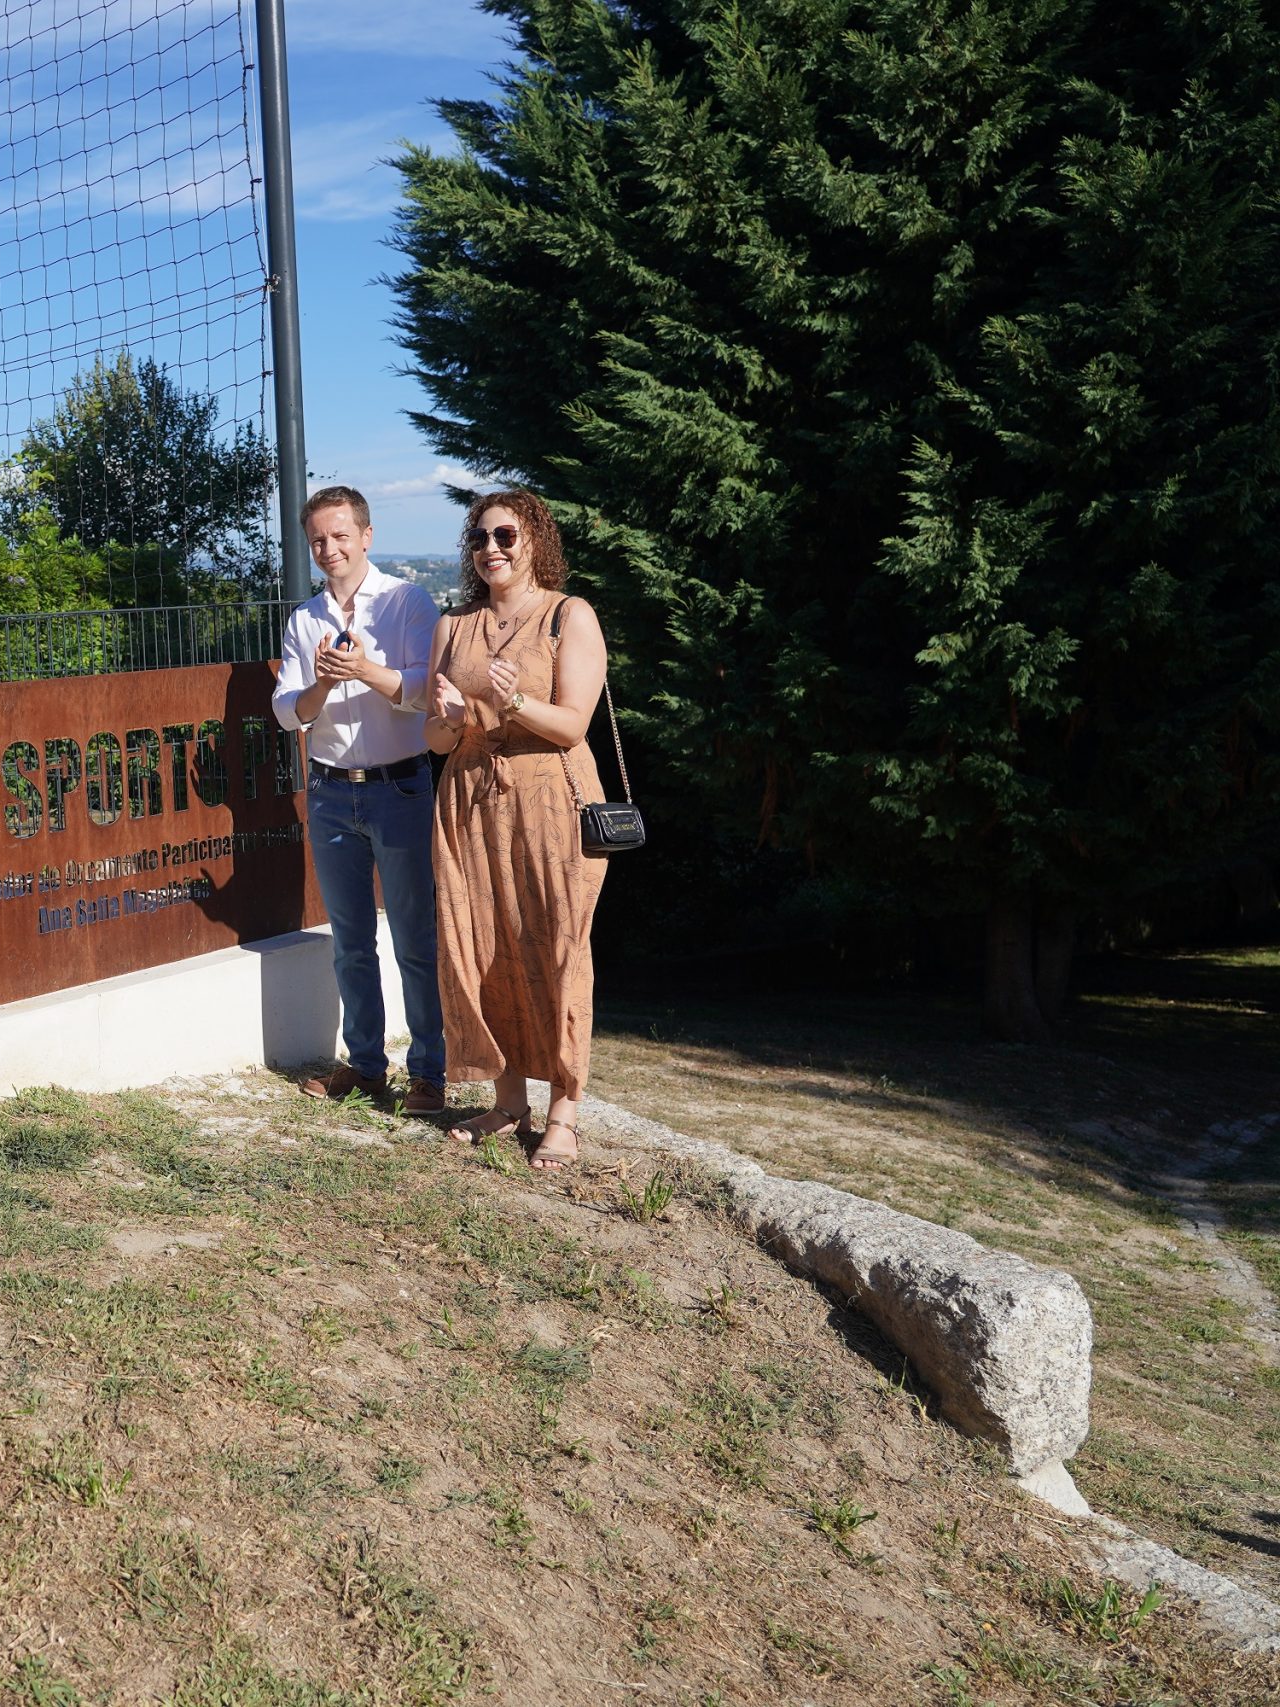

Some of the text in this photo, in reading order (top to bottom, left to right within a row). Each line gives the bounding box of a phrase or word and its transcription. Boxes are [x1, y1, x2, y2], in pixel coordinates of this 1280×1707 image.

[0, 717, 228, 839] SPORTS
[38, 905, 73, 935] Ana
[76, 893, 120, 928] Sofia
